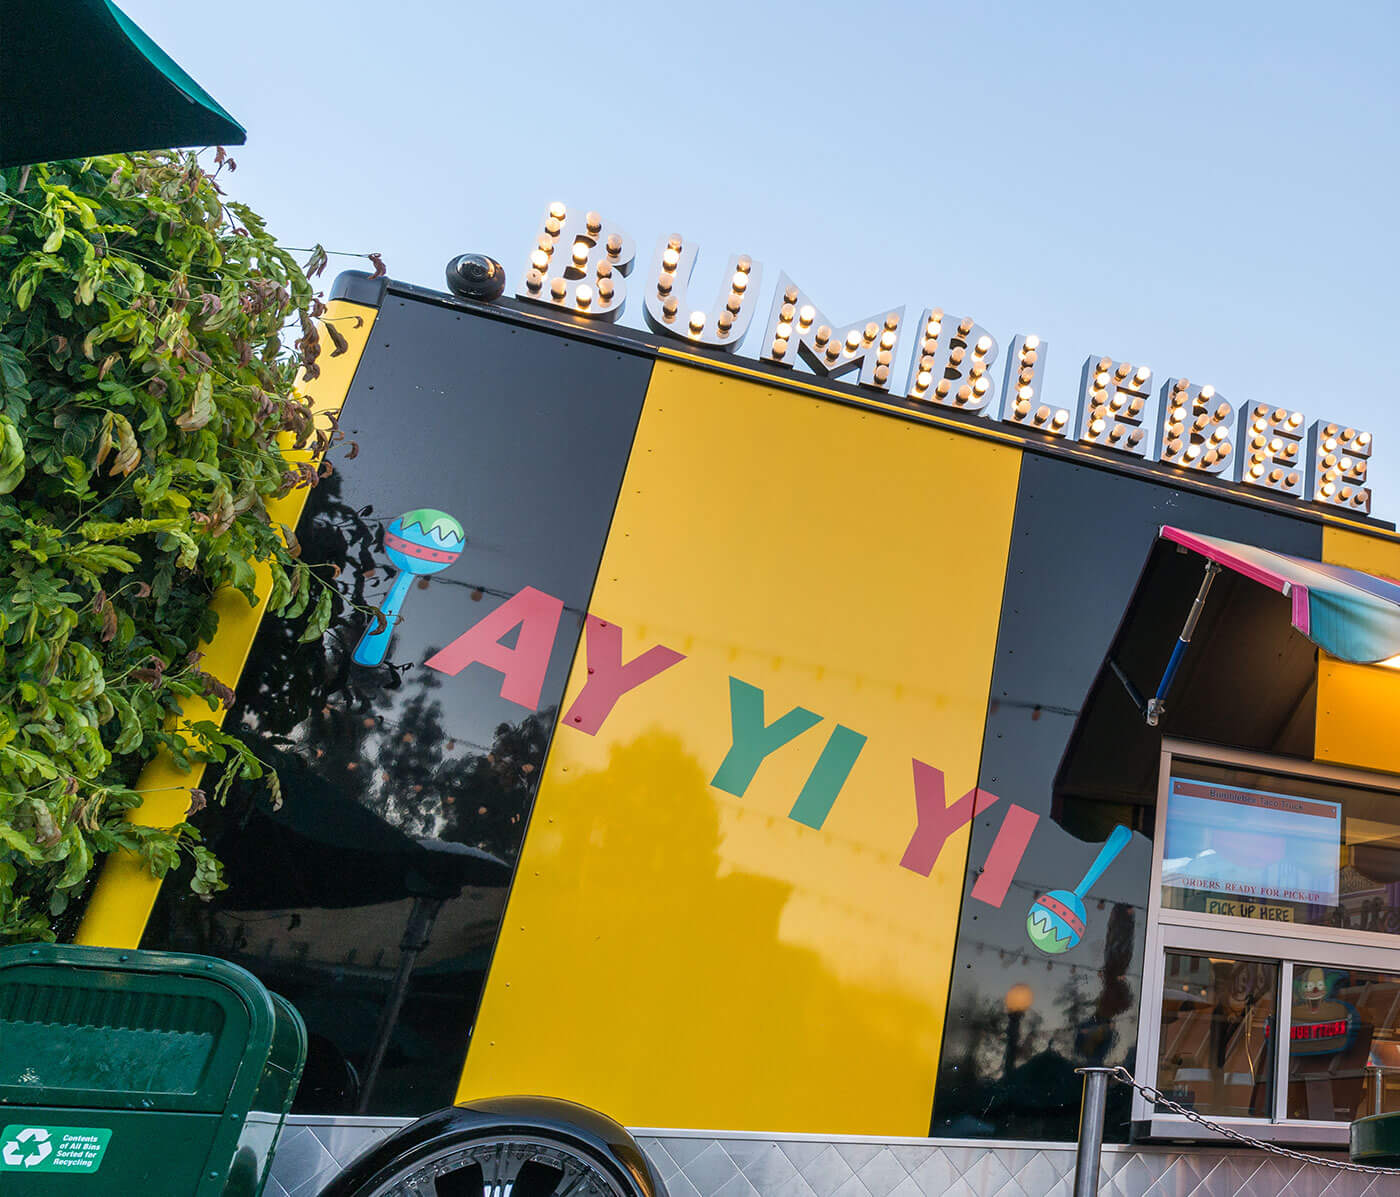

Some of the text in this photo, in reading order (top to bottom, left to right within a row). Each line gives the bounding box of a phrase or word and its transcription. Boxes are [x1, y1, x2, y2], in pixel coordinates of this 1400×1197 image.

[515, 200, 1373, 515] BUMBLEBEE
[424, 586, 1039, 908] AY YI YI
[1209, 789, 1304, 810] Bumblebee Taco Truck
[1182, 878, 1321, 902] ORDERS READY FOR PICK-UP
[1209, 901, 1290, 922] PICK UP HERE
[63, 1134, 98, 1142] Contents
[83, 1143, 100, 1151] Bins
[53, 1158, 93, 1168] Recycling
[56, 1150, 97, 1159] Sorted for
